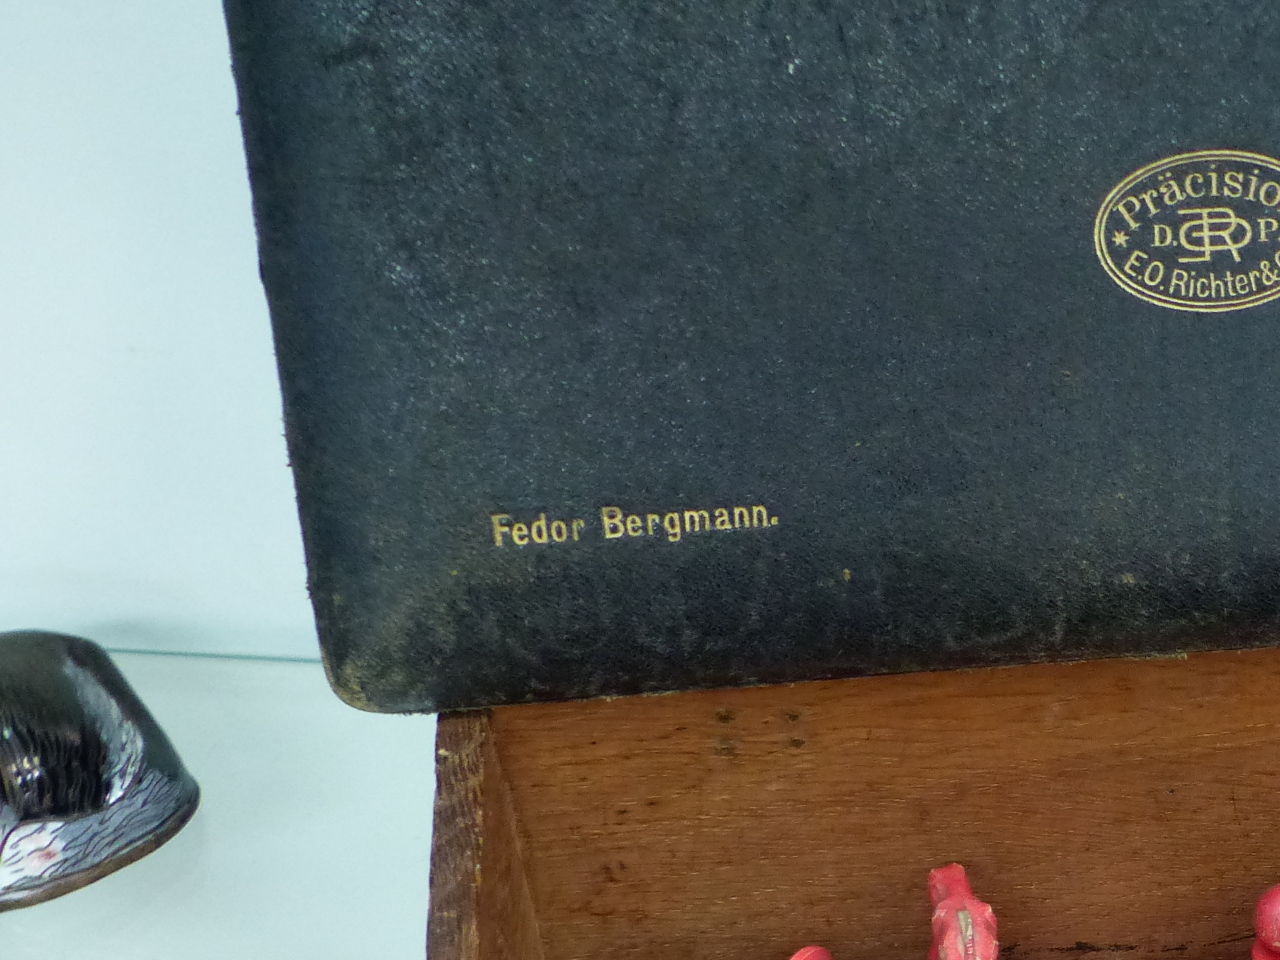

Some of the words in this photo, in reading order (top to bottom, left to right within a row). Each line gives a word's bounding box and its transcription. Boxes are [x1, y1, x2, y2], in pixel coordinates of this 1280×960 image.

[1151, 223, 1179, 247] D.
[490, 512, 586, 547] Fedor
[600, 504, 779, 543] Bergmann.
